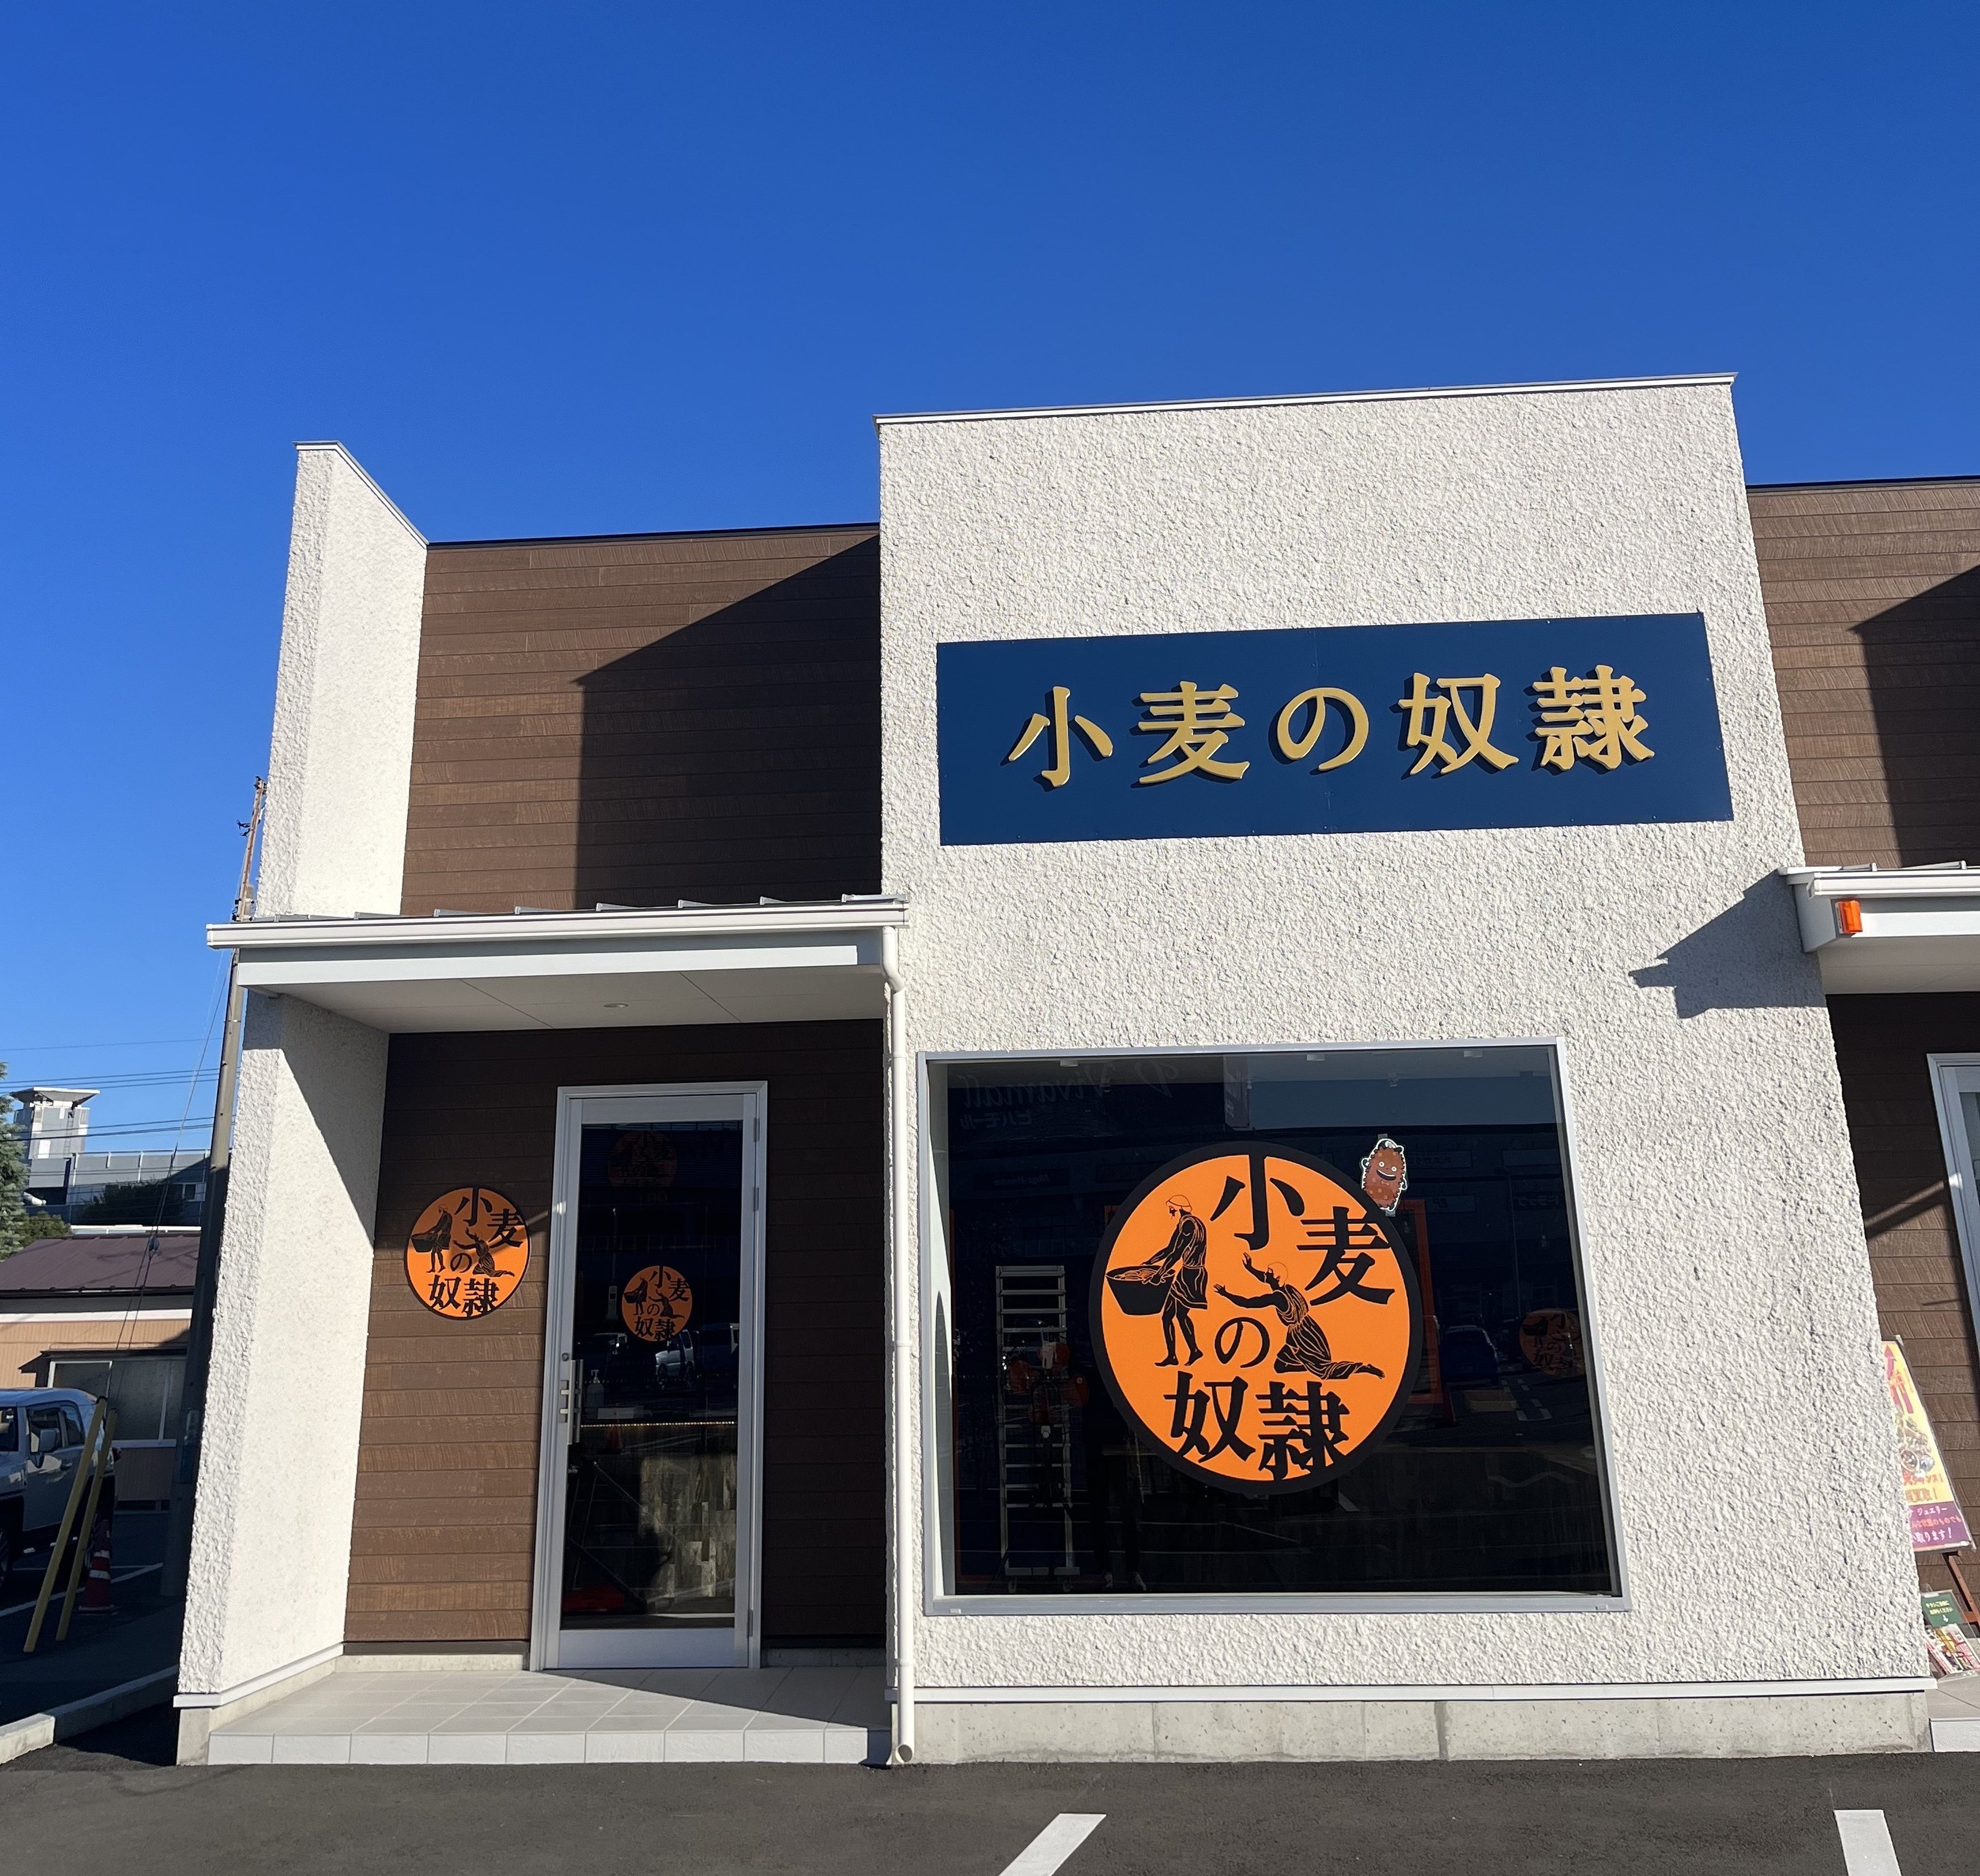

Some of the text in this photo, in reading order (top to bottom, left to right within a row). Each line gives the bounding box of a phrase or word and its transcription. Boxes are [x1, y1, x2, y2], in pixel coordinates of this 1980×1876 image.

[1009, 665, 1655, 787] 小麦の奴隷
[428, 1275, 499, 1316] 奴隷
[1164, 1371, 1348, 1479] 奴隷
